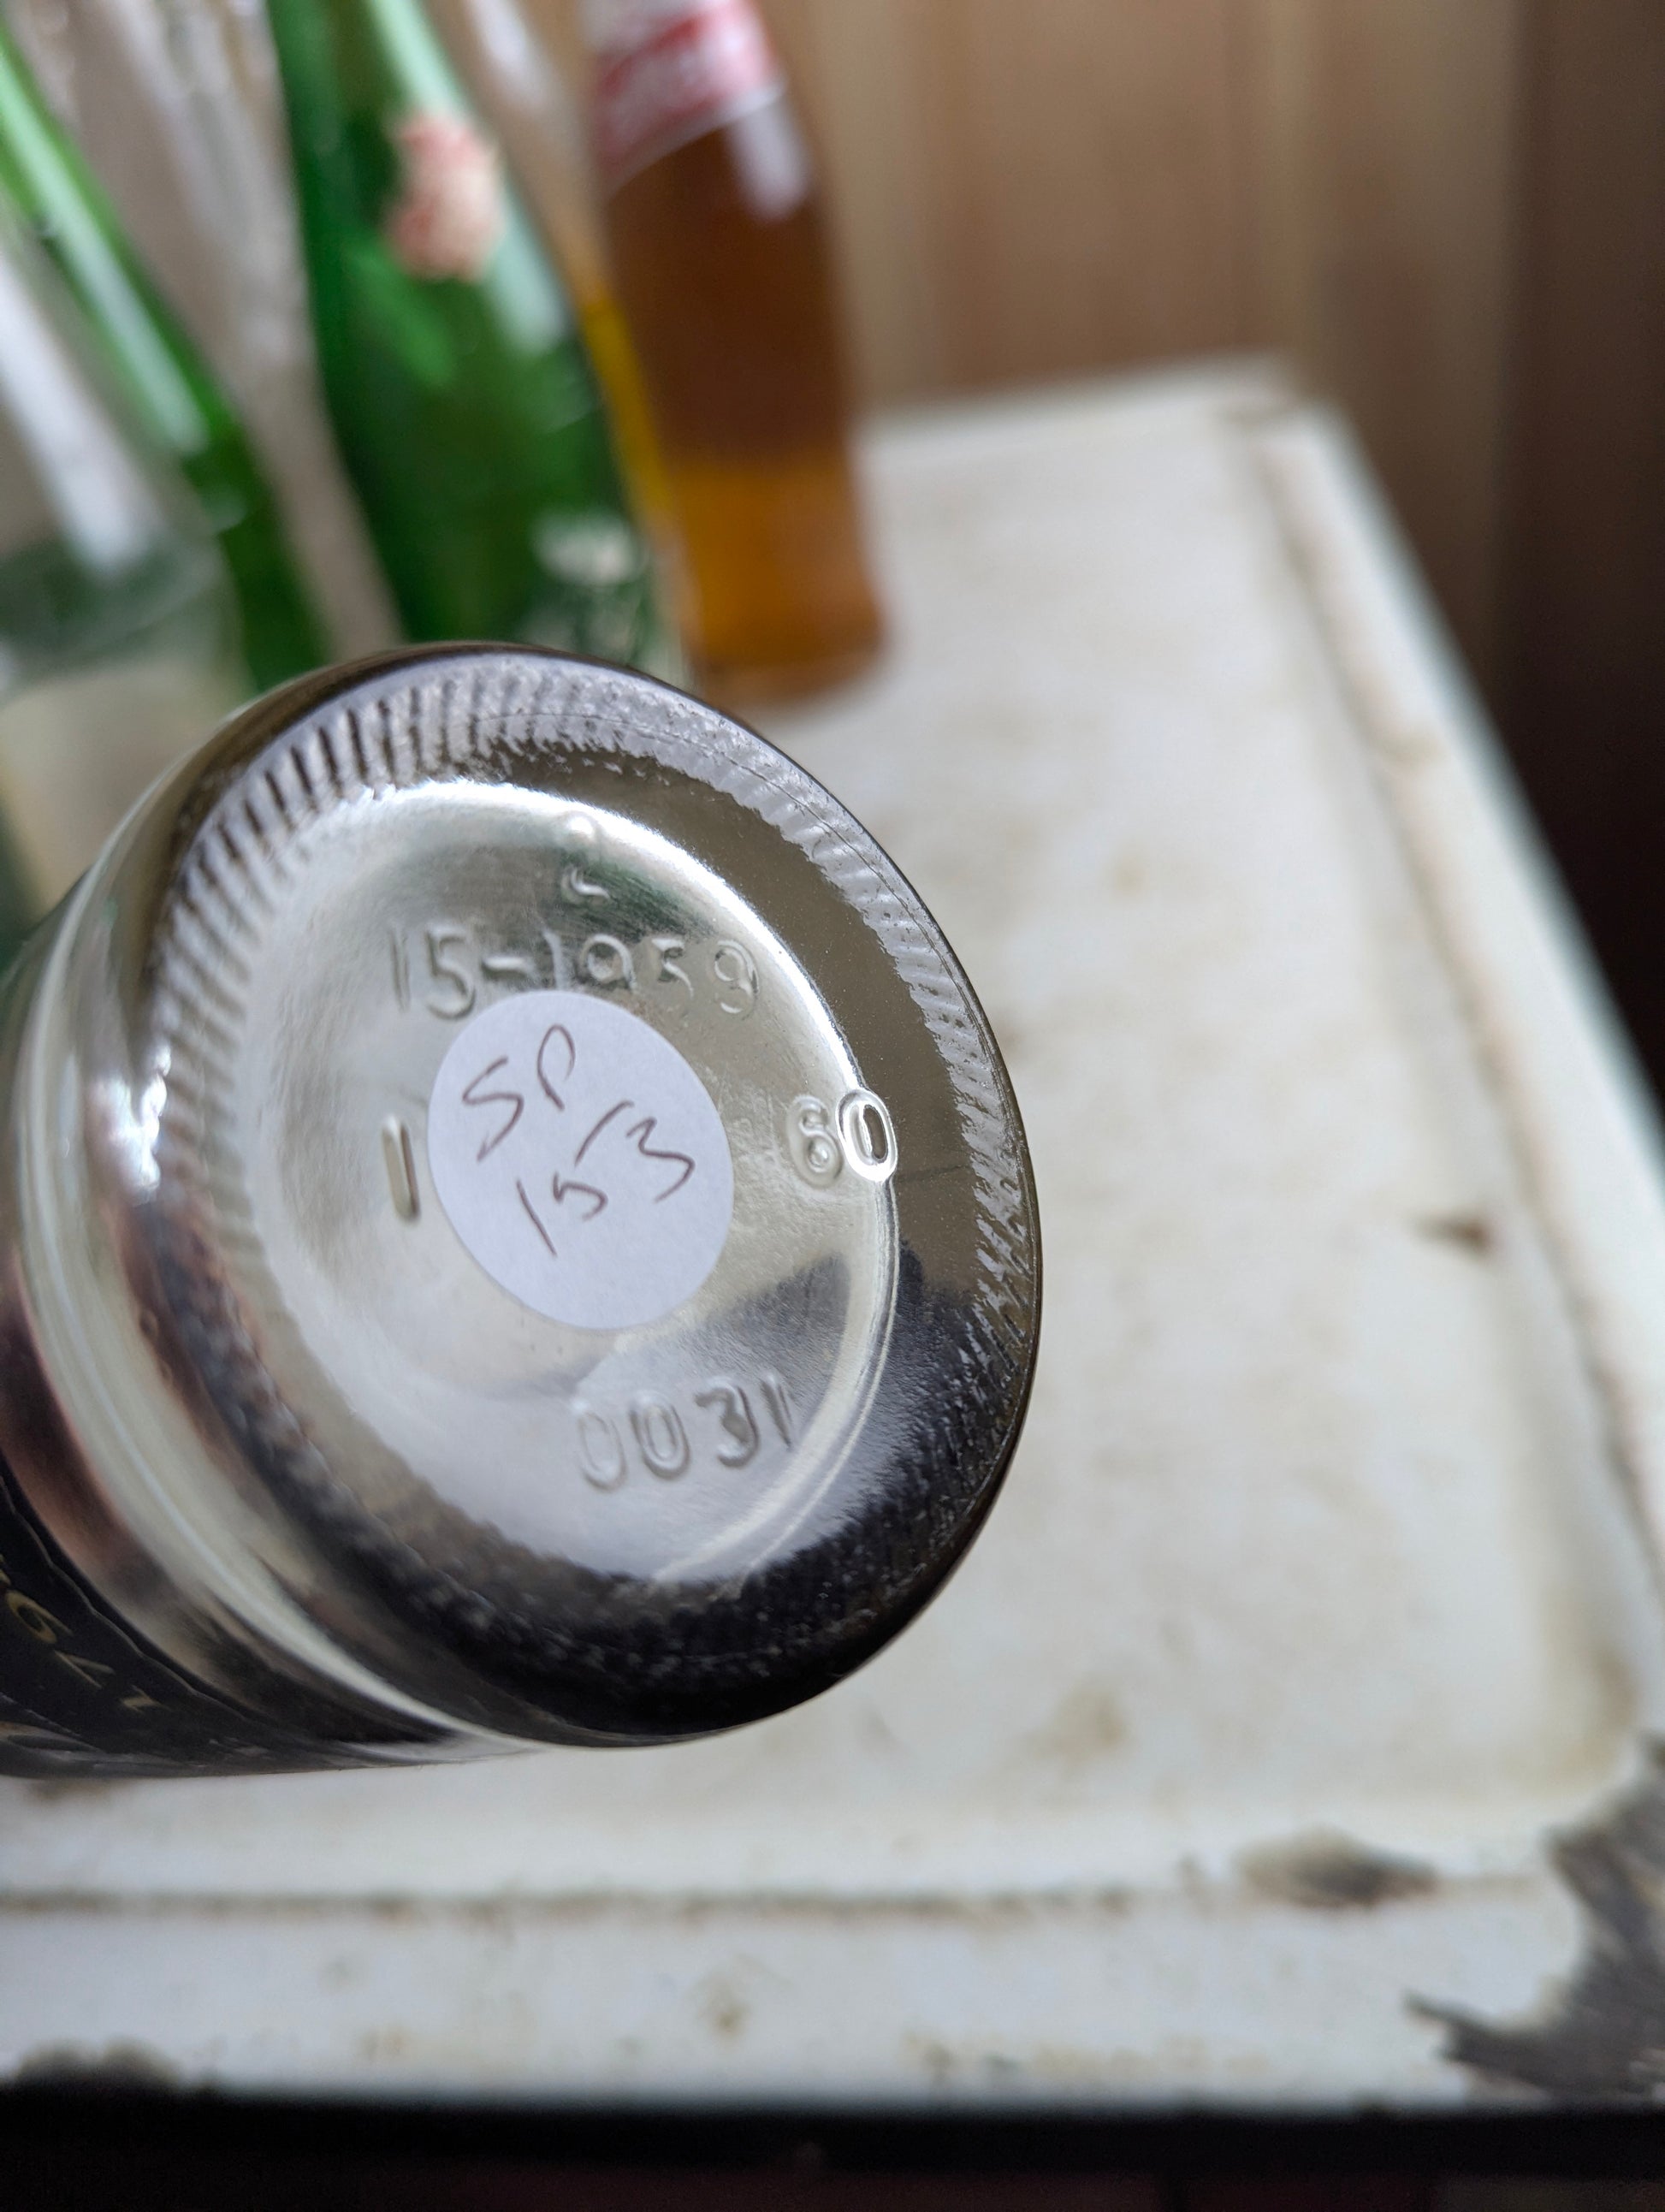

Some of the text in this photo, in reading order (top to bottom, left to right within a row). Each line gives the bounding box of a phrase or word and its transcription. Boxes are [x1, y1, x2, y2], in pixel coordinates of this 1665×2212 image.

[461, 1023, 576, 1162] SP
[573, 1376, 793, 1492] 0031
[0, 1551, 169, 1712] 179
